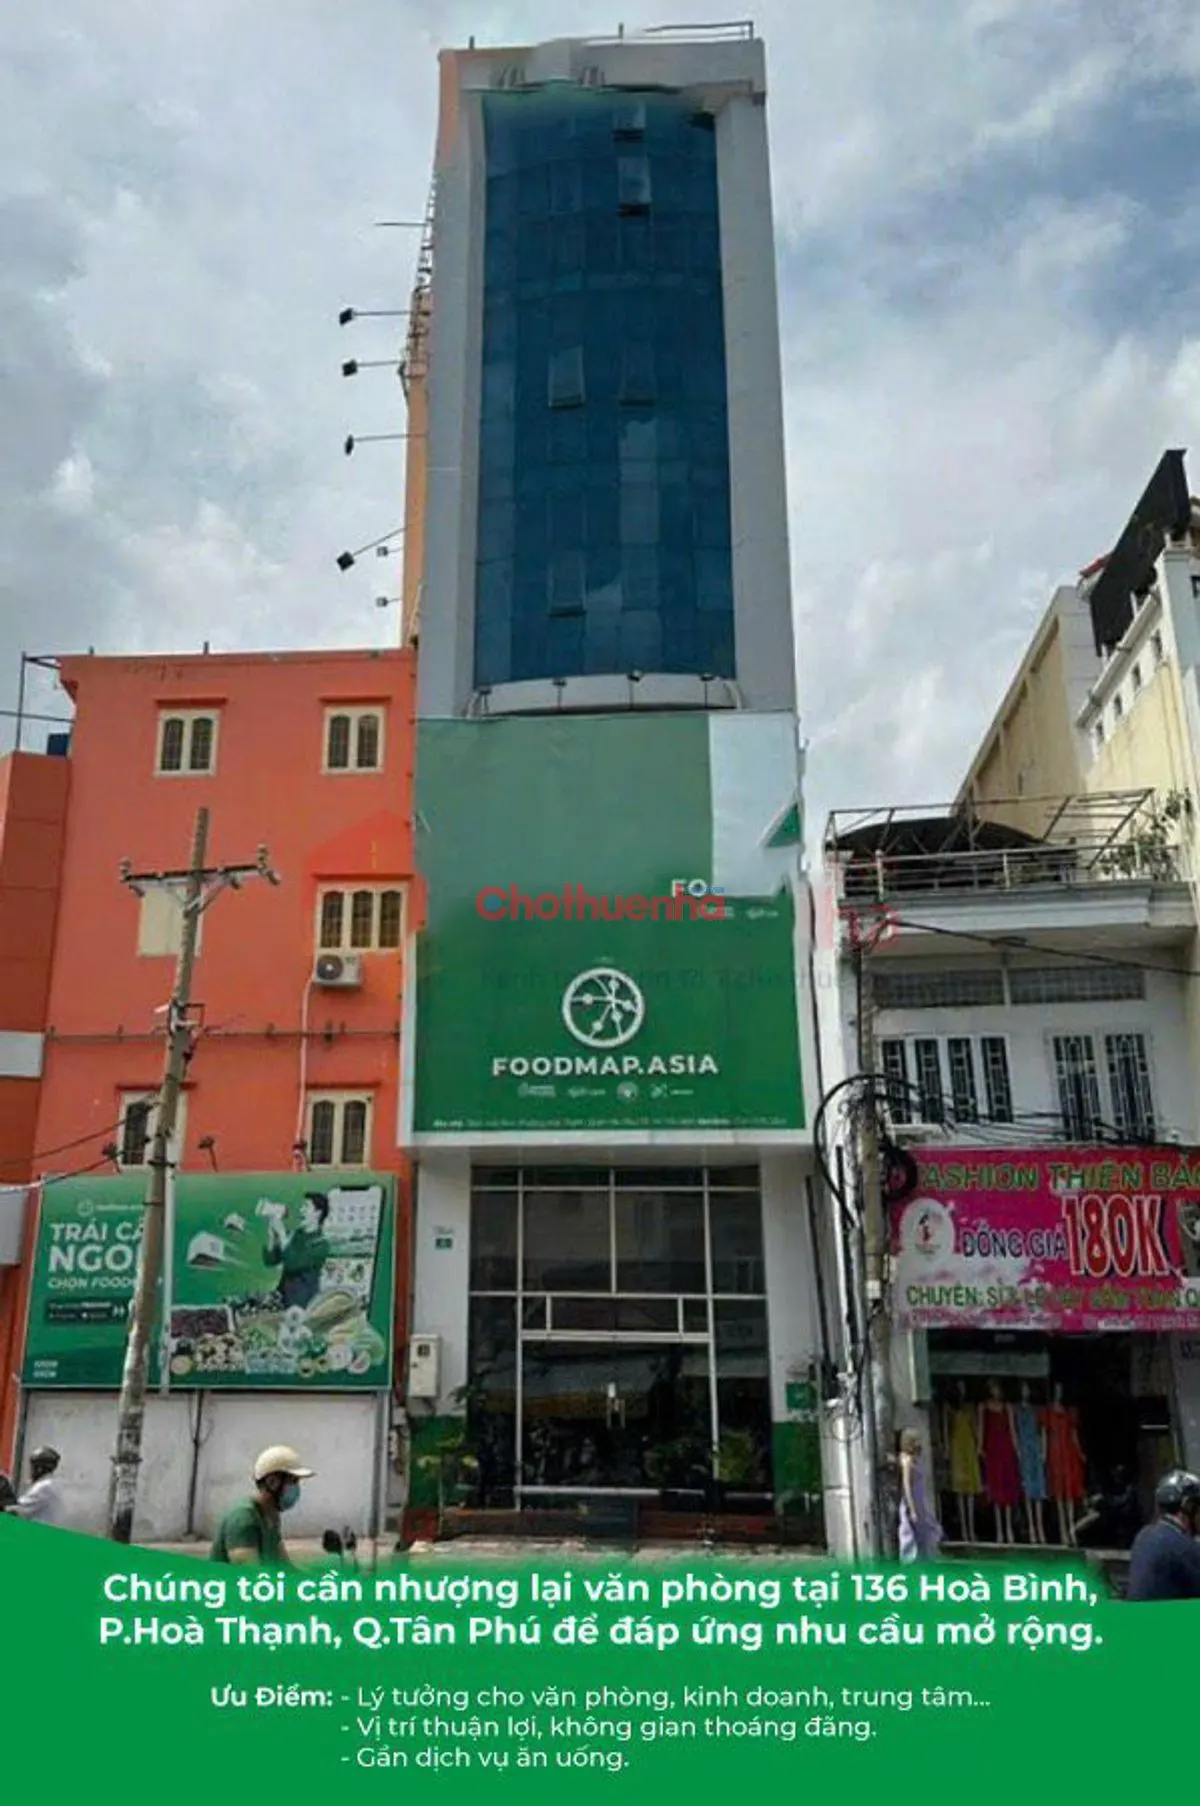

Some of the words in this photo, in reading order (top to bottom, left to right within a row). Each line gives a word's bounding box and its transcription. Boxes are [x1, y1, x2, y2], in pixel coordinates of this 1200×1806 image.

[492, 1054, 719, 1077] FOODMAP.ASIA
[49, 1217, 109, 1242] TRÁI
[1062, 1194, 1170, 1278] 180K
[48, 1243, 140, 1273] NGO
